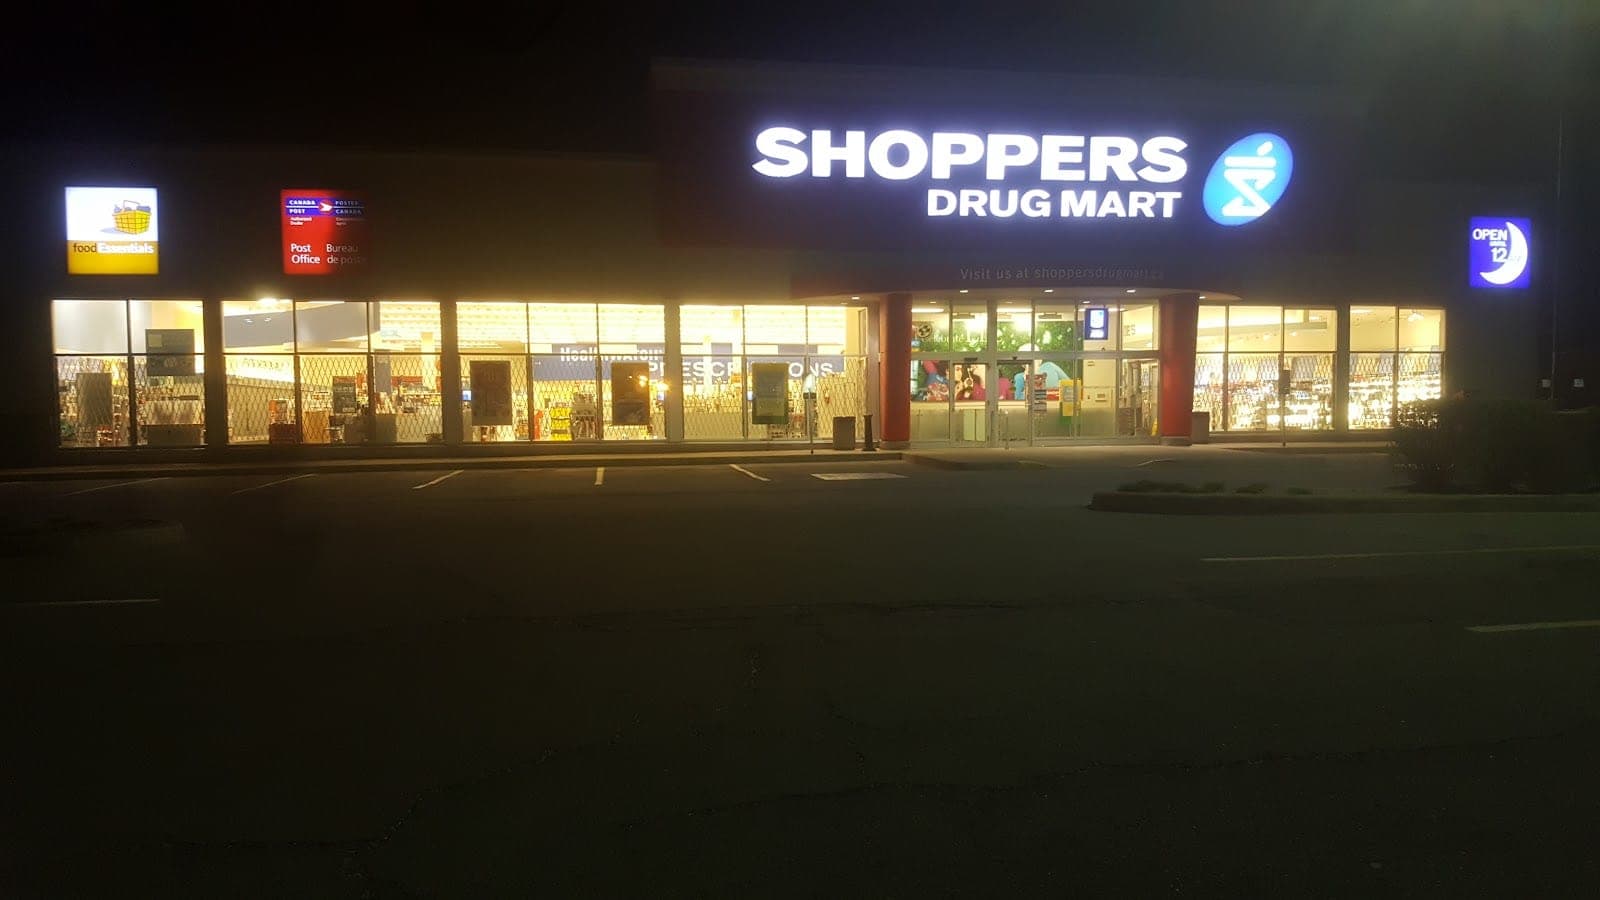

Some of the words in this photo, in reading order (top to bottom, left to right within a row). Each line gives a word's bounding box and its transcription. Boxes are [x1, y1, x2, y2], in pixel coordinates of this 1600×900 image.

[751, 126, 1188, 183] SHOPPERS
[927, 189, 1051, 218] DRUG
[1060, 190, 1183, 219] MART
[1472, 228, 1508, 241] OPEN
[290, 243, 312, 253] Post
[326, 243, 359, 253] Bureau
[291, 254, 321, 264] Office
[327, 254, 340, 264] de
[1490, 247, 1507, 263] 12
[959, 267, 992, 281] Visit
[996, 269, 1012, 281] us
[1015, 267, 1029, 280] at
